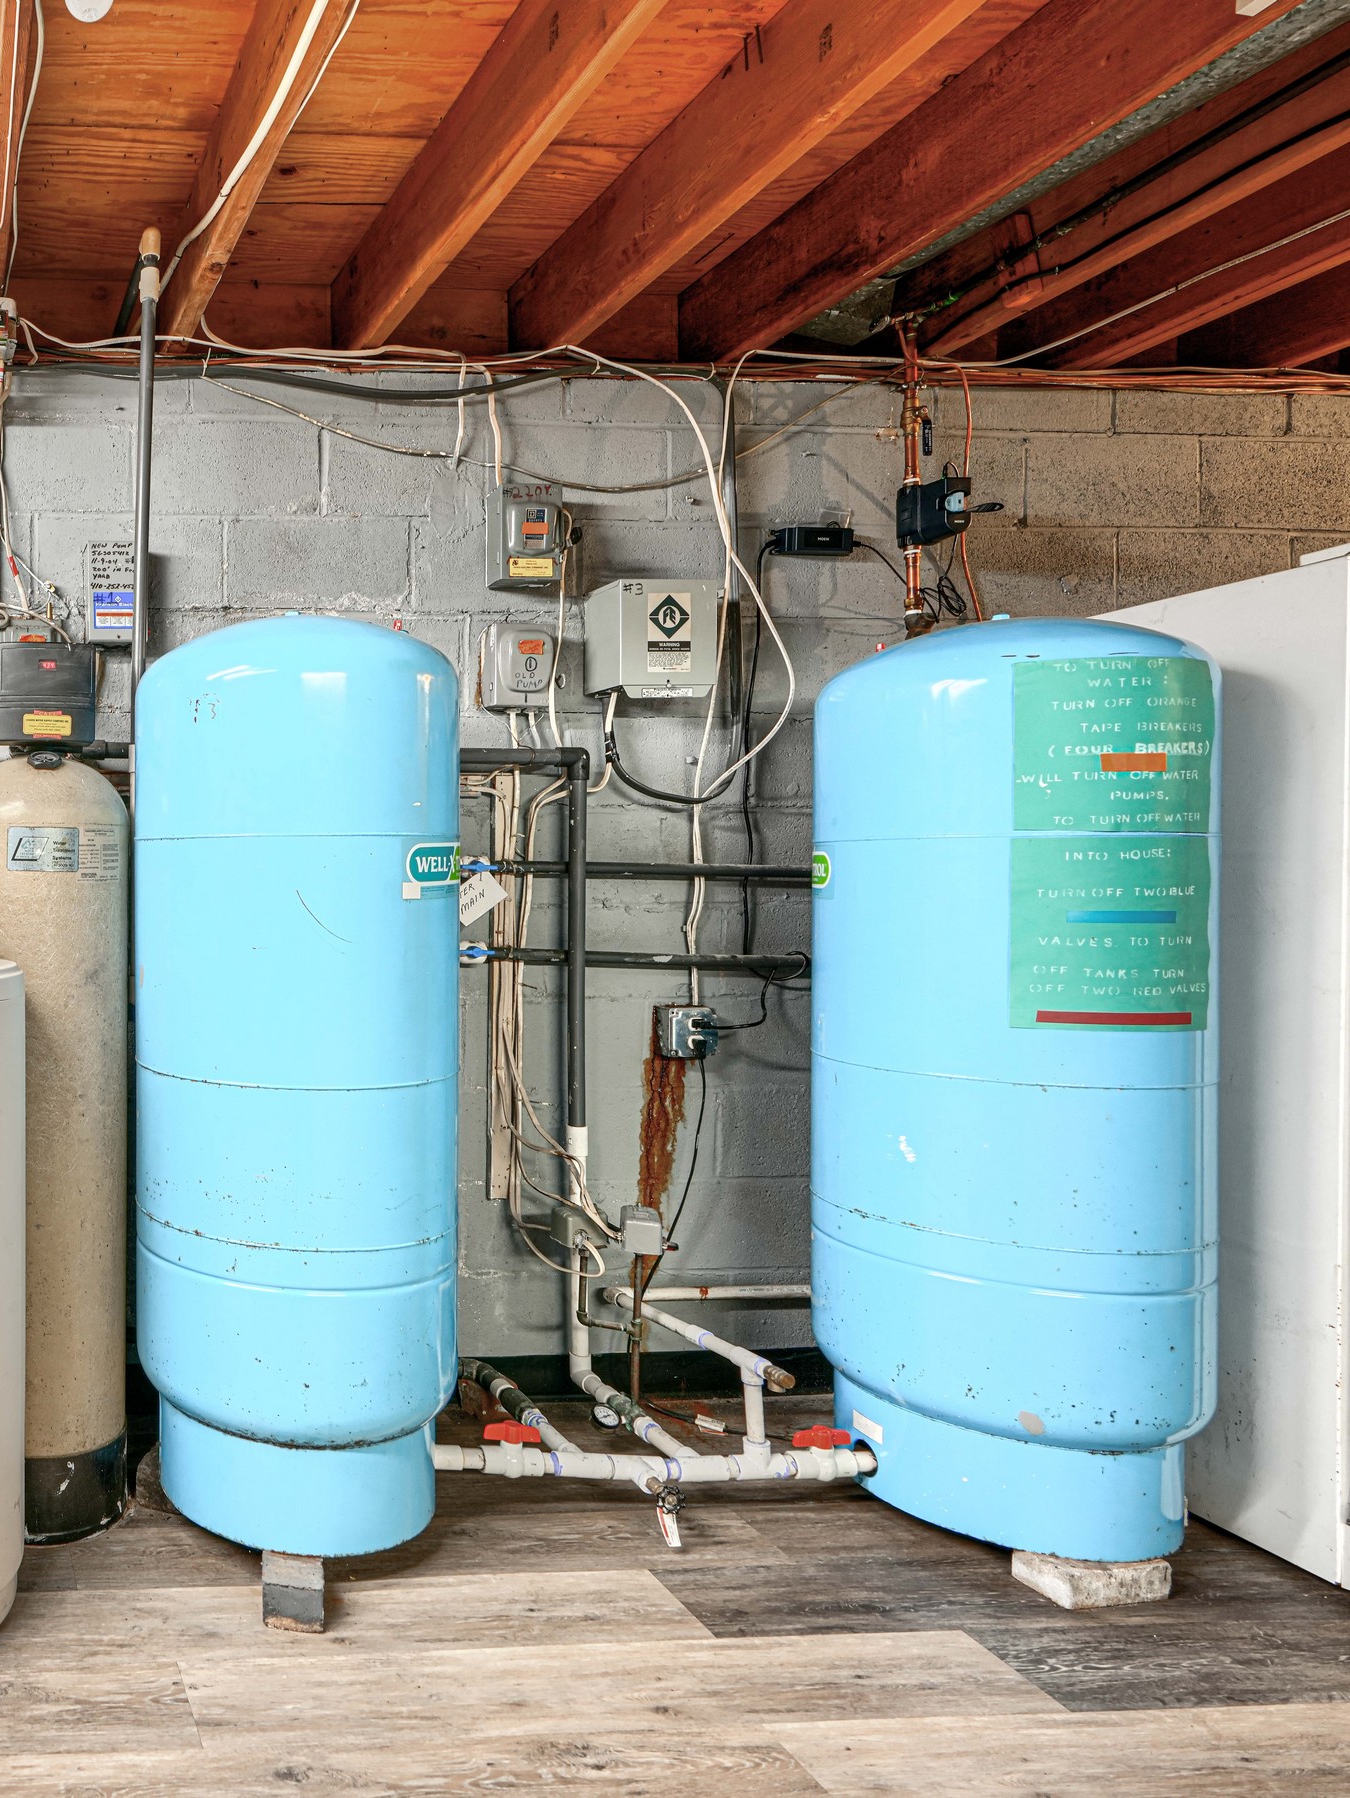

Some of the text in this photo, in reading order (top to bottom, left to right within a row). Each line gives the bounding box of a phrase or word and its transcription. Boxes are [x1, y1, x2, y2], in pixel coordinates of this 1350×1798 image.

[623, 583, 643, 596] #3
[1053, 658, 1170, 672] TO TURN OFF
[516, 679, 543, 688] PUMP
[1051, 697, 1197, 711] TURN OFF ORANGE
[1080, 722, 1202, 733] TAPE BREAKERS
[1072, 771, 1117, 780] TURN
[1130, 770, 1155, 780] OFF
[1163, 769, 1199, 780] WATER
[1110, 790, 1169, 800] PUMPS.
[1053, 812, 1200, 826] TO TURN OFF WATER
[1065, 848, 1171, 861] INTO HOUSE:
[1037, 886, 1196, 898] TURN OFF TWO BLUE
[460, 889, 486, 915] MAIN
[1130, 937, 1149, 946] TO
[1160, 936, 1192, 946] TURN
[1033, 965, 1185, 979] OFF TANKS TURN
[1029, 983, 1207, 997] OFF TWO RED VALVES
